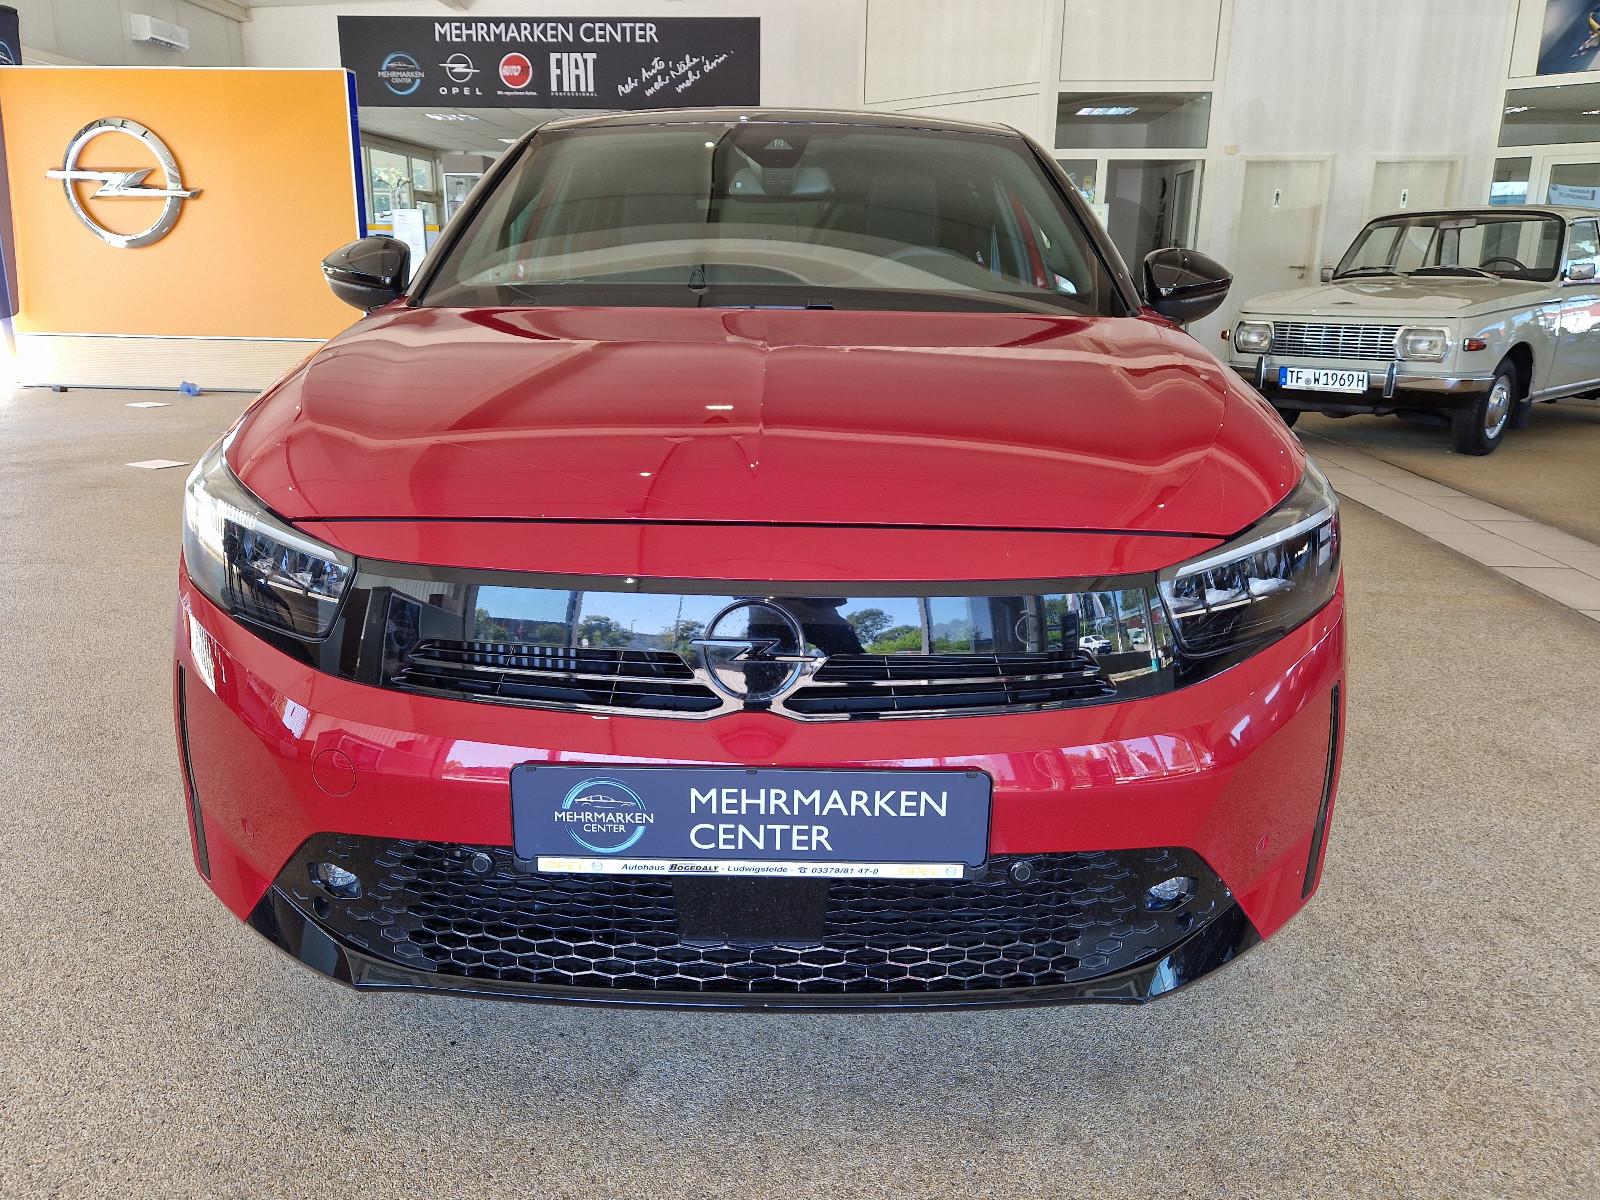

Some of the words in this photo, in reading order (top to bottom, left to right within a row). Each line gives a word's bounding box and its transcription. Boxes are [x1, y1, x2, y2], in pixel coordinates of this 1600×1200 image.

[434, 22, 574, 42] MEHRMARKEN
[579, 23, 659, 43] CENTER
[549, 52, 597, 92] FIAT
[439, 87, 483, 95] OPEL
[1288, 370, 1304, 384] TF
[690, 788, 948, 817] MEHRMARKEN
[554, 811, 654, 824] MEHRMARKEN
[583, 824, 626, 833] CENTER
[689, 824, 834, 851] CENTER
[621, 863, 665, 872] Autohaus
[727, 864, 788, 874] Ludwigsfelde
[811, 866, 855, 875] 03378/81
[858, 867, 879, 875] 47-0
